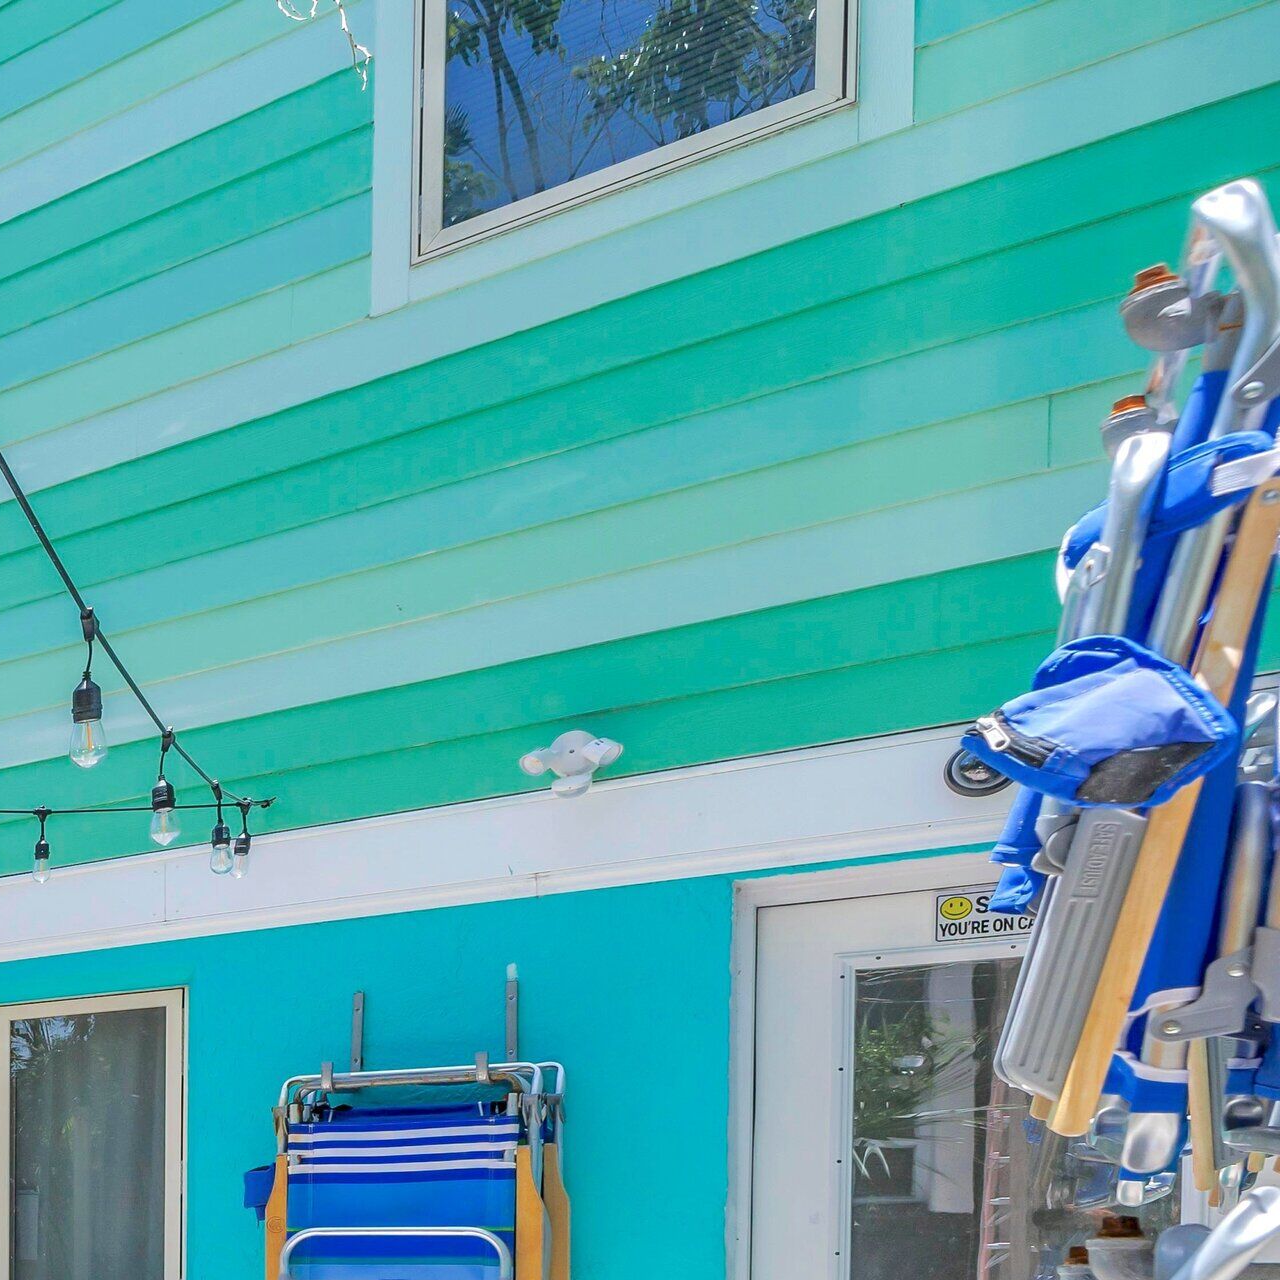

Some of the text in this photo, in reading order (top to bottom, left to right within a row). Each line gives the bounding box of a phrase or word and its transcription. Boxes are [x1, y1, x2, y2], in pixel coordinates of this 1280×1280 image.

[975, 895, 993, 914] S
[939, 919, 990, 937] YOU'RE
[992, 917, 1014, 932] ON
